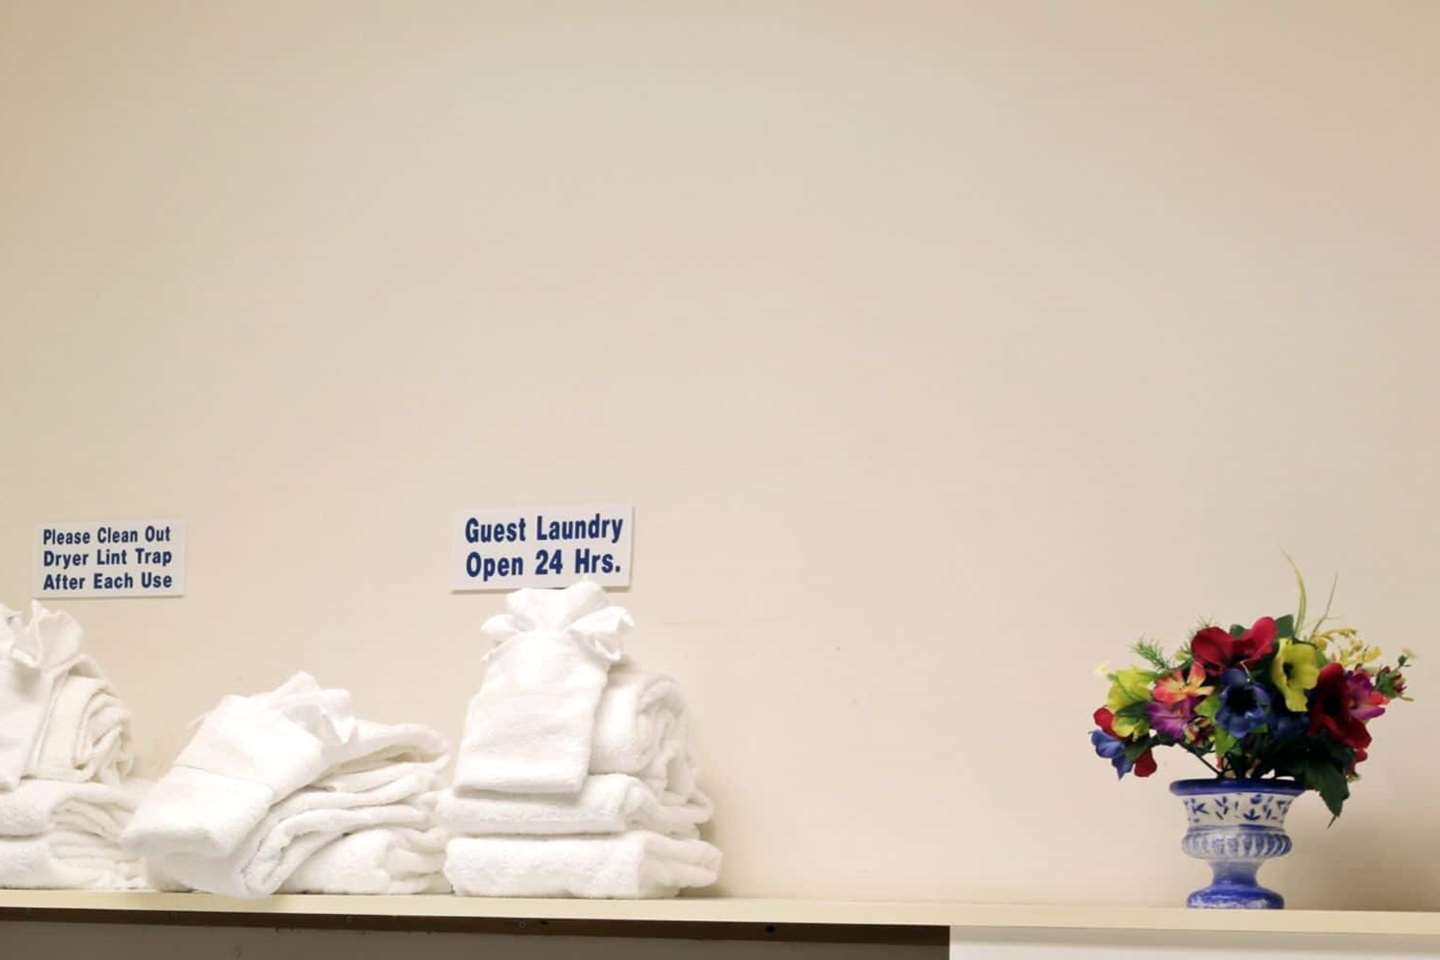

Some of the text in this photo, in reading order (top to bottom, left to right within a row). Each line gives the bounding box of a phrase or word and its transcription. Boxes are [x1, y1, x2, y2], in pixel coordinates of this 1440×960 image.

[43, 525, 171, 545] Please Clean Out
[465, 513, 623, 544] Guest Laundry
[43, 548, 172, 570] Dryer Lint Trap
[466, 548, 621, 582] Open 24 Hrs.
[43, 571, 172, 591] After Each Use
